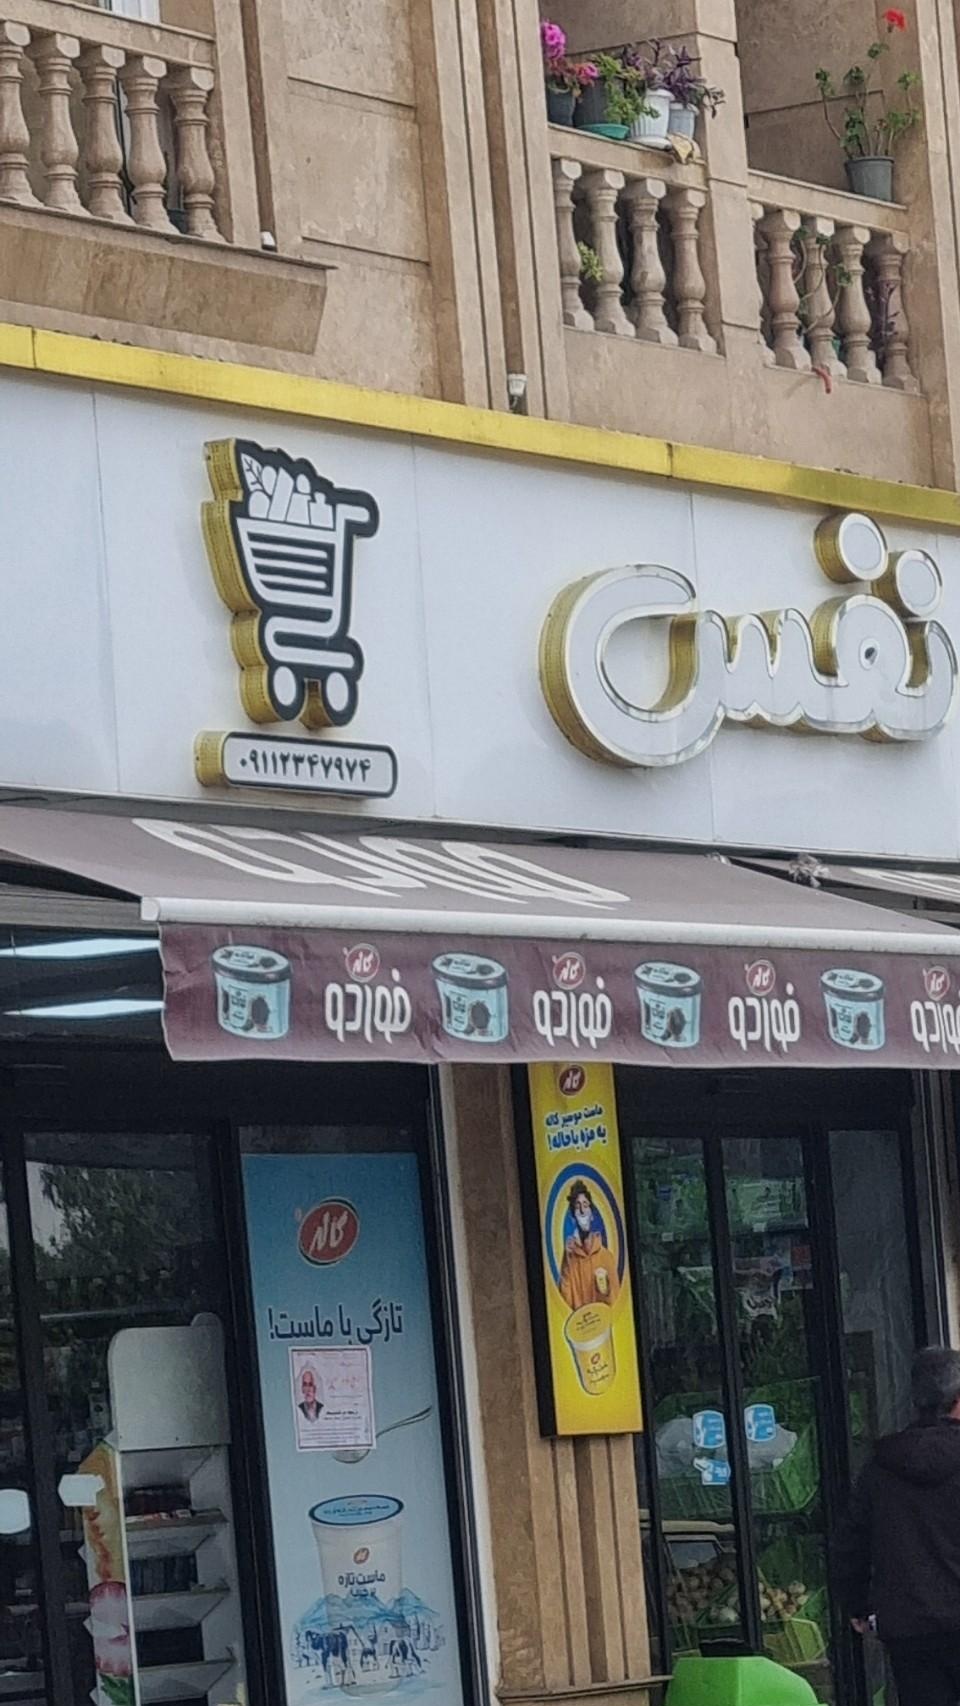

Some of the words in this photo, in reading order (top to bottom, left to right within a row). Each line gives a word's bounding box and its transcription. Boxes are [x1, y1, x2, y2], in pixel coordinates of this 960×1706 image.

[542, 512, 960, 769] نفس
[240, 749, 372, 783] ۰۹۱۱۲۳۴۷۹۷۴
[583, 1104, 603, 1118] ماست
[268, 1305, 334, 1340] ماست!
[339, 1304, 353, 1345] با
[357, 1298, 403, 1345] تازگی
[338, 1572, 355, 1588] تازه
[356, 1570, 386, 1586] ماست
